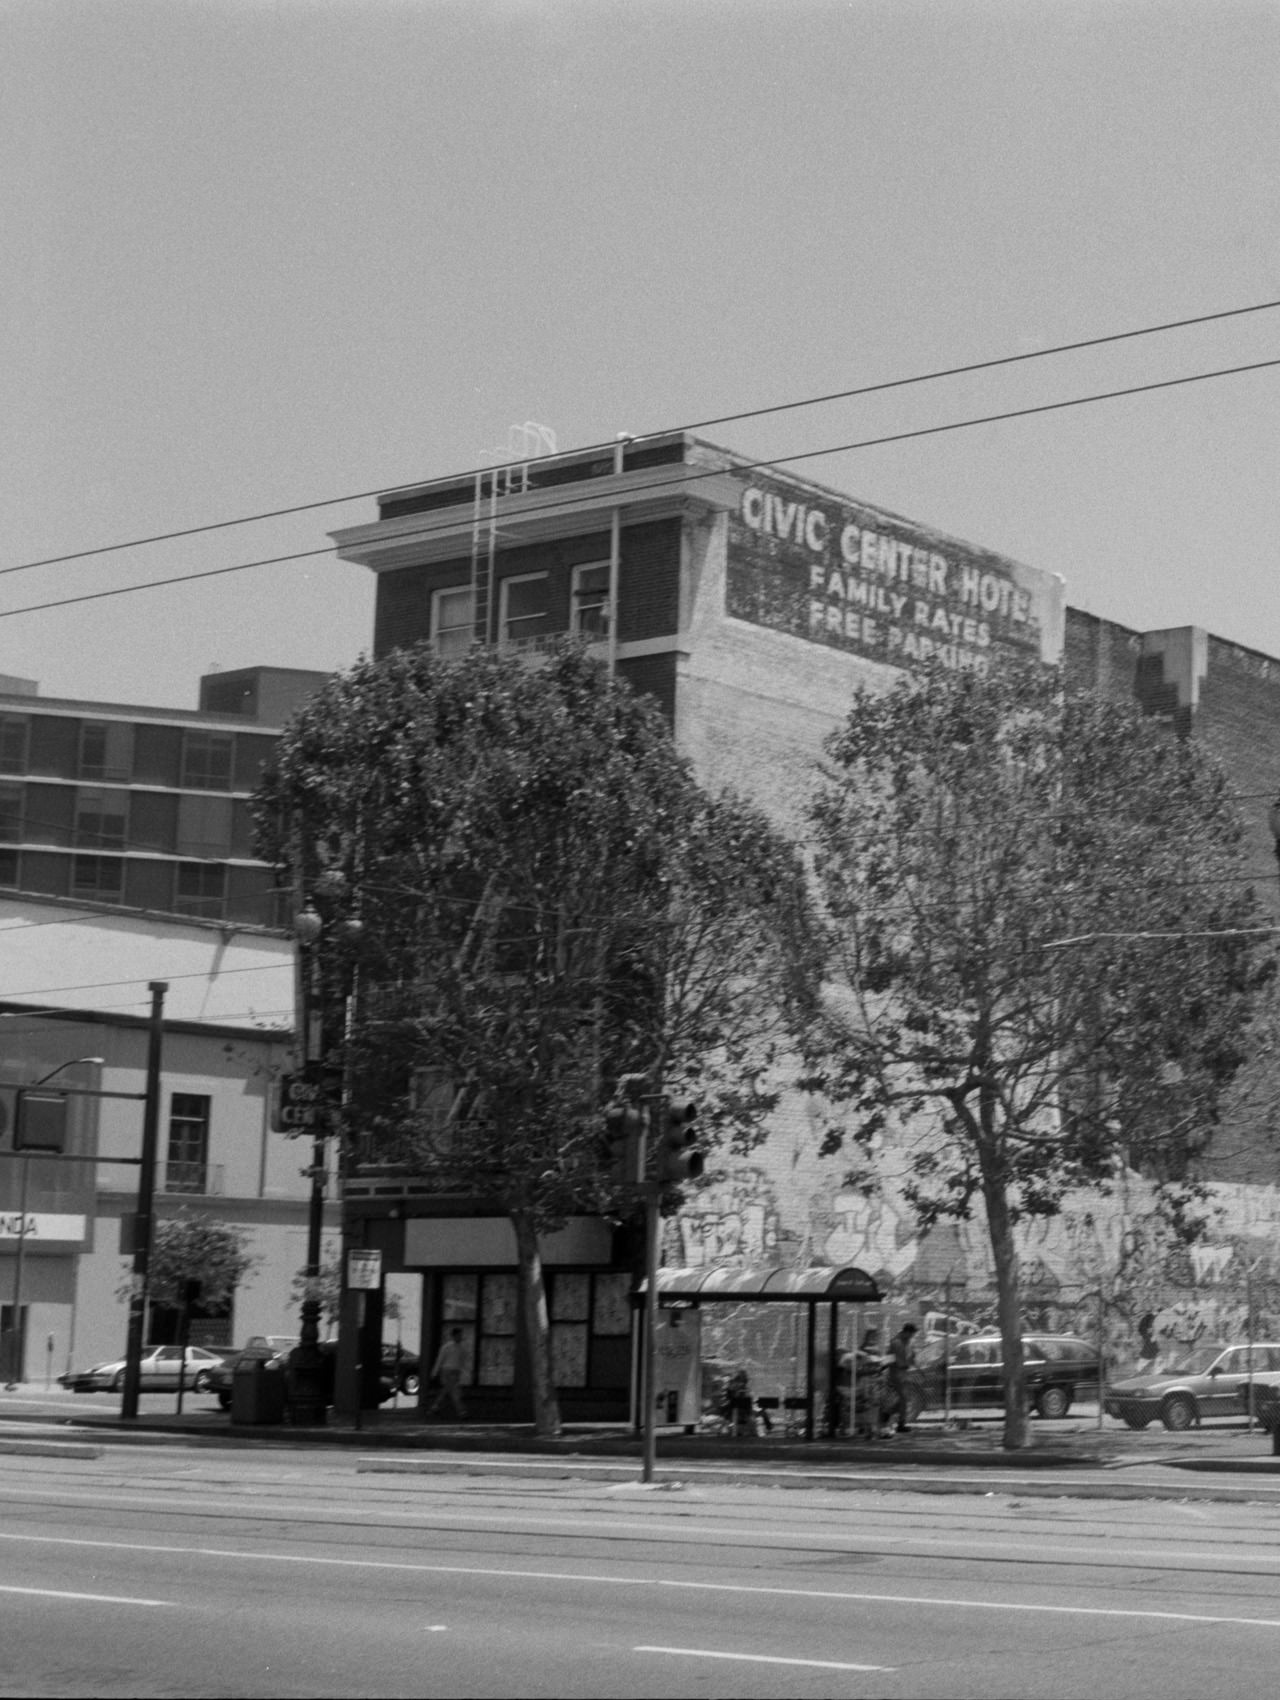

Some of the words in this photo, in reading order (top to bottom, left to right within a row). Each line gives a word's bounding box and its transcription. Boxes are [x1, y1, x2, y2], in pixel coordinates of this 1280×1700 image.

[742, 488, 827, 551] CIVIC
[840, 525, 949, 597] CENTER
[808, 564, 907, 618] FAMILY
[914, 601, 990, 647] RATES
[808, 600, 877, 645] FREE
